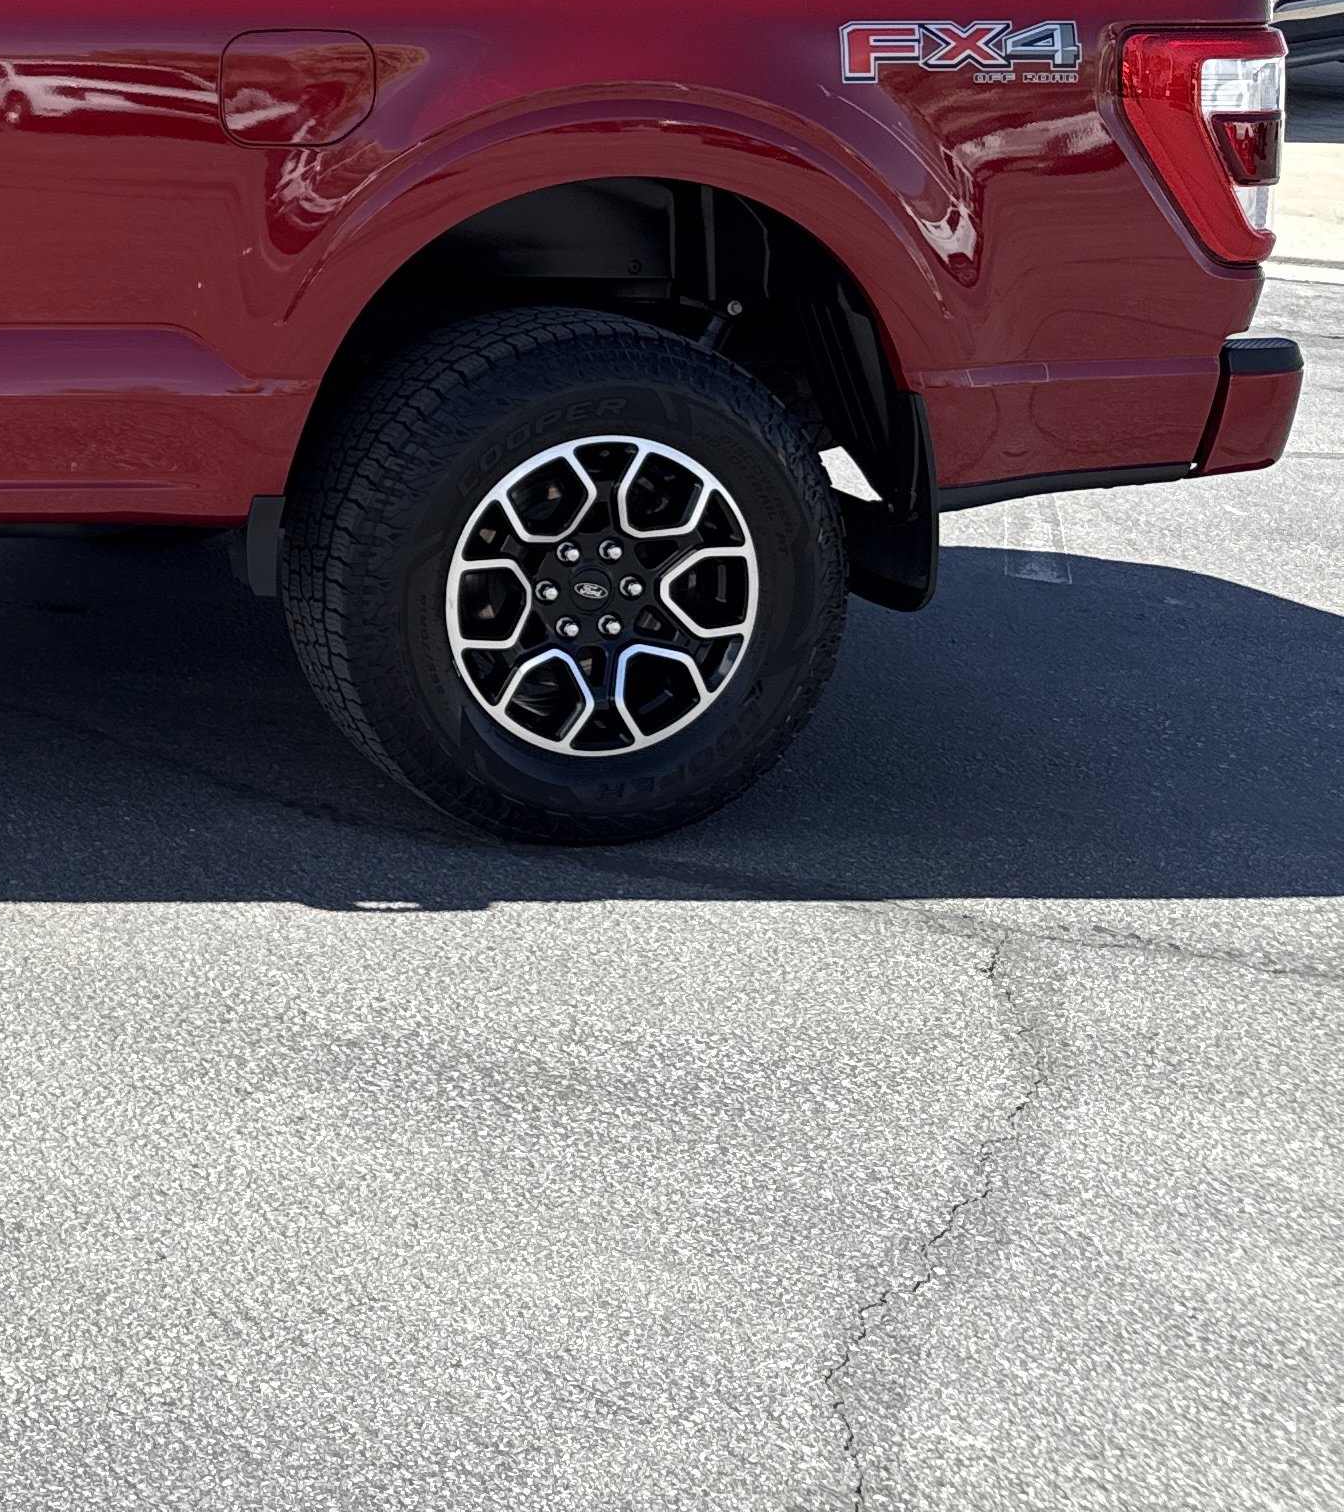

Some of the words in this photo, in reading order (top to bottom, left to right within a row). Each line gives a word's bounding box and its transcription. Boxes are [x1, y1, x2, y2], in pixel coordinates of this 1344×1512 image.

[839, 20, 1083, 84] FX4
[972, 72, 1016, 84] OFF
[1022, 72, 1079, 84] ROAD
[455, 396, 628, 497] COOPER
[576, 583, 606, 598] Ford
